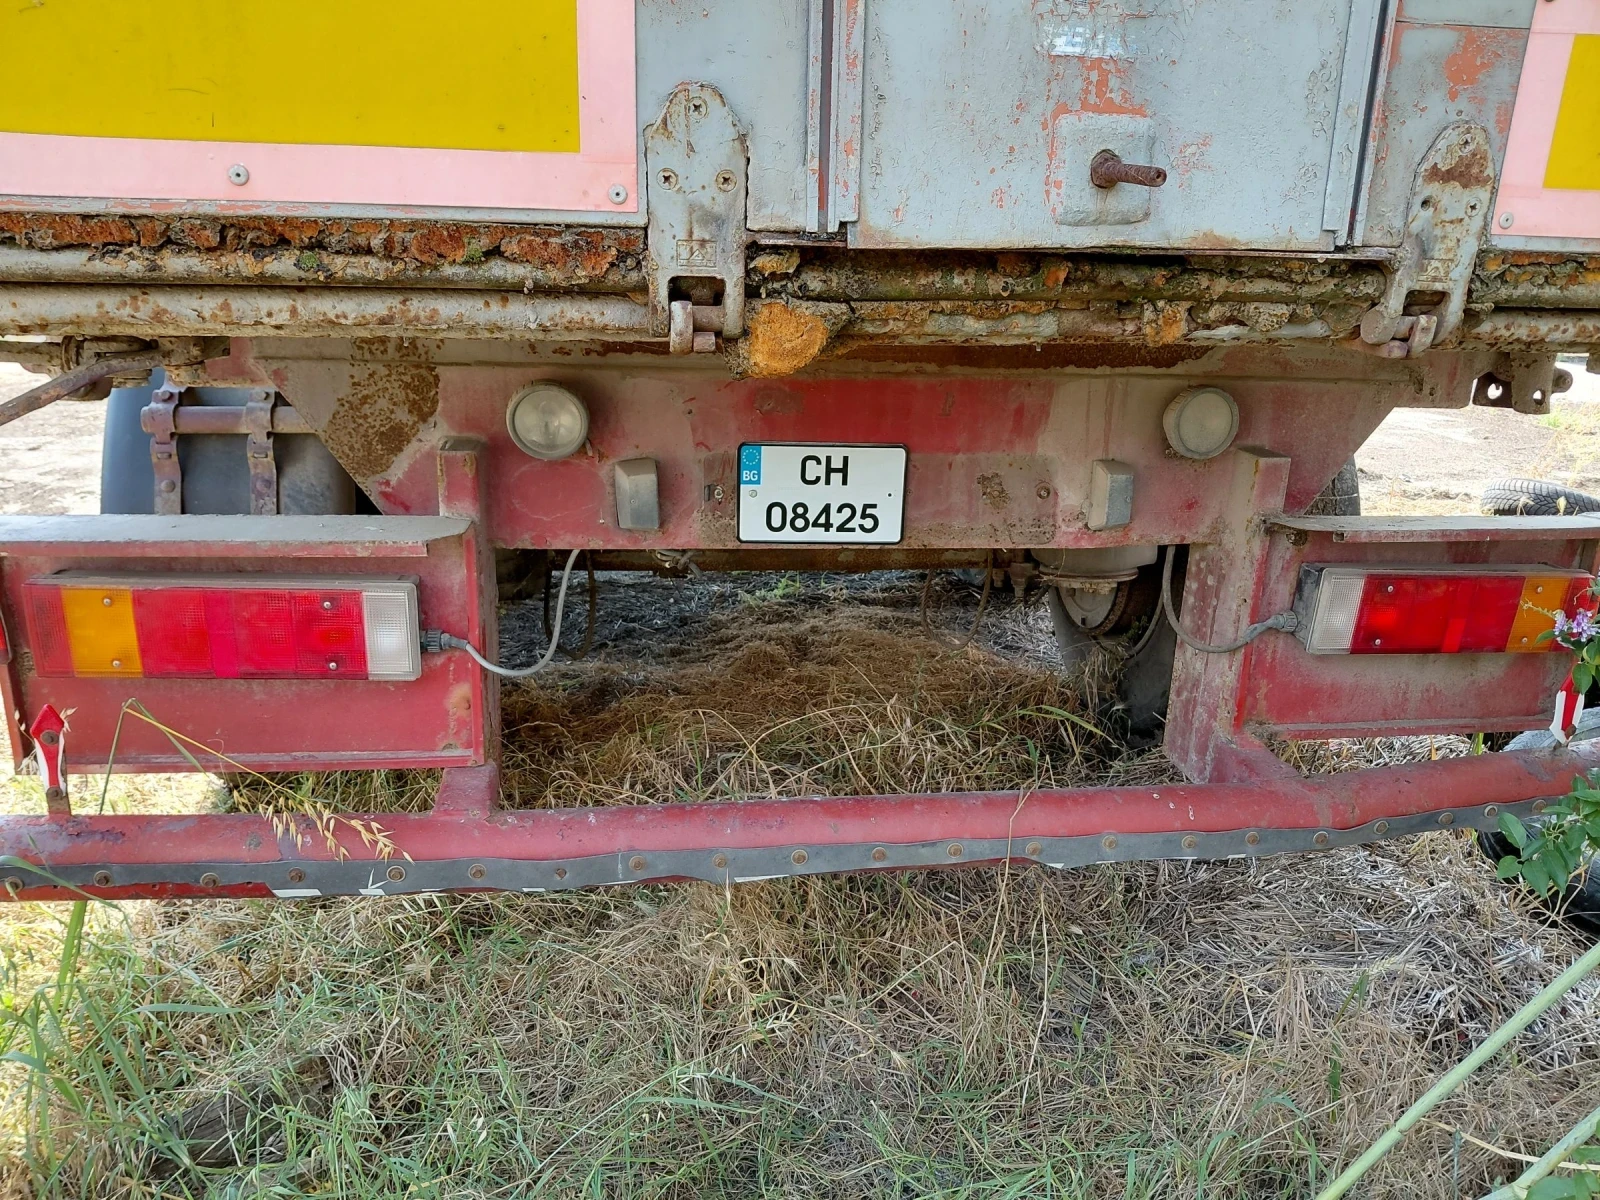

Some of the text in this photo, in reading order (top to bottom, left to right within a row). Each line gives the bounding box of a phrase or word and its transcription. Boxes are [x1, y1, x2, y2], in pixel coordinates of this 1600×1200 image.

[743, 470, 759, 481] BG
[800, 455, 849, 486] CH
[765, 501, 880, 534] 08425
